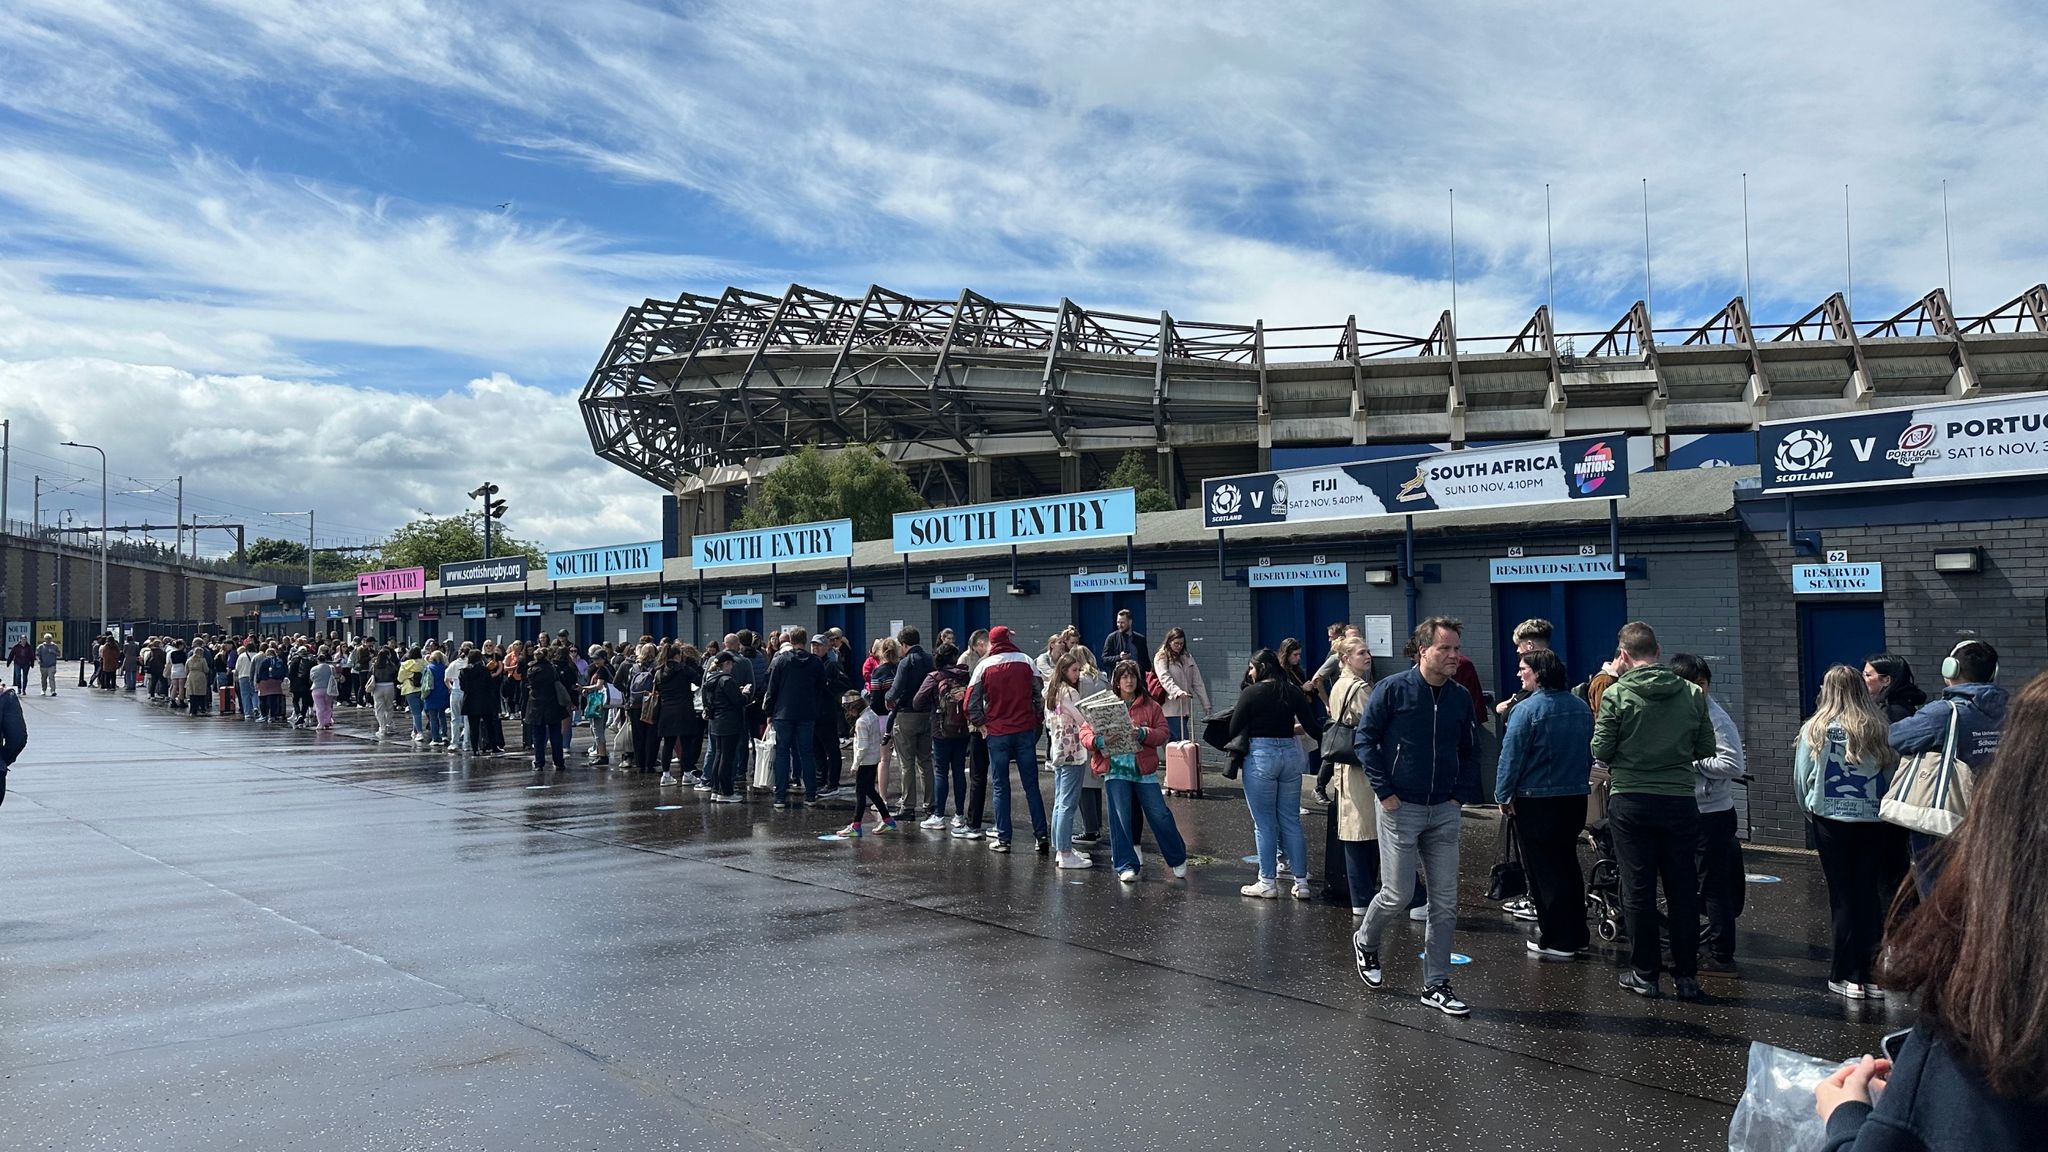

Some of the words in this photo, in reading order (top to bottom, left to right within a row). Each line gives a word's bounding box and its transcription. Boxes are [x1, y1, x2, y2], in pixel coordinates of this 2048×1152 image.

[1947, 414, 2048, 439] PORTU
[1849, 437, 1876, 462] V
[1887, 449, 1938, 459] PORTUGAL
[1948, 447, 1975, 460] SAT
[1980, 445, 1994, 457] 16
[1999, 441, 2039, 456] NOV,
[1430, 462, 1487, 481] SOUTH
[1492, 455, 1559, 474] AFRICA
[1574, 459, 1615, 475] NATIONS
[1775, 471, 1834, 483] SCOTLAND
[1312, 478, 1337, 493] FIJI
[1445, 484, 1465, 496] SUN
[1468, 483, 1479, 494] 10
[1481, 481, 1506, 493] NOV,
[1507, 477, 1544, 490] 4.10PM
[1250, 491, 1264, 508] V
[1289, 500, 1304, 509] SAT
[1304, 499, 1309, 508] 2
[1310, 497, 1331, 508] NOV,
[1332, 495, 1364, 506] 5.40PM
[910, 510, 996, 546] SOUTH
[1010, 498, 1109, 537] ENTRY
[703, 535, 762, 563] SOUTH
[771, 527, 836, 557] ENTRY
[1509, 547, 1522, 556] 64
[1581, 545, 1594, 555] 63
[555, 552, 598, 575] SOUTH
[605, 547, 651, 571] ENTRY
[1315, 556, 1325, 564] 65
[1829, 552, 1845, 562] 62
[446, 563, 521, 581] www.scottishrugby.org
[1253, 571, 1298, 581] RESERVED
[1299, 569, 1340, 579] SEATING
[1496, 563, 1558, 575] RESERVED
[1803, 567, 1870, 578] RESERVED
[370, 574, 390, 592] WEST
[391, 571, 418, 590] ENTRY
[1073, 578, 1108, 588] RESERVED
[1809, 578, 1866, 589] SEATING
[932, 586, 960, 594] RESERVED
[960, 584, 986, 592] SEATING
[8, 625, 28, 633] SOUTH
[42, 624, 57, 632] EAST
